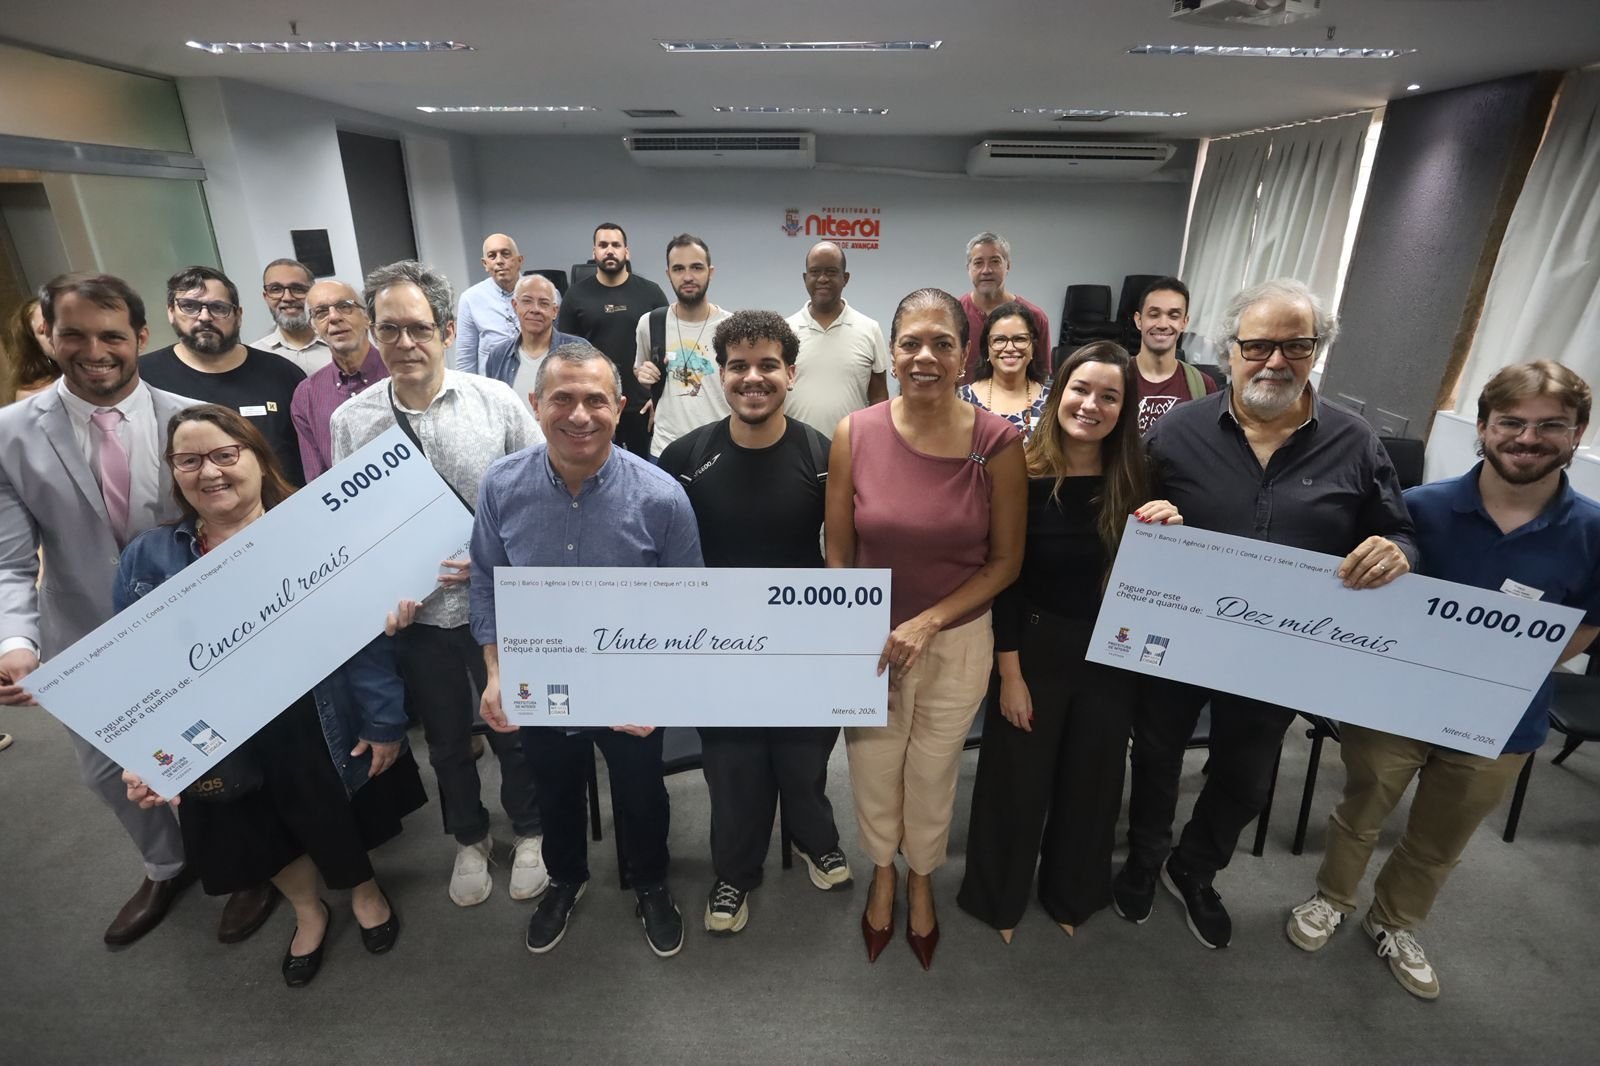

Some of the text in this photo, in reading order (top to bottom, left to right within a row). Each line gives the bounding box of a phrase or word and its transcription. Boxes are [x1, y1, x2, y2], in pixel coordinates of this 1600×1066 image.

[851, 242, 879, 250] AVANÇAR
[321, 443, 411, 512] 5.000,00
[447, 547, 464, 560] terói,
[1135, 529, 1153, 538] Comp
[1158, 534, 1177, 543] Banco
[1182, 539, 1206, 548] Agência
[1211, 544, 1221, 552] DV
[1240, 550, 1258, 559] Conta
[1299, 562, 1323, 573] Cheque
[767, 586, 883, 609] 20.000,00
[1116, 590, 1147, 602] cheque
[1155, 599, 1188, 611] quantia
[1189, 605, 1203, 615] de:
[1118, 582, 1181, 602] Pague por este
[38, 678, 59, 694] Comp
[63, 661, 85, 676] Banco
[89, 640, 114, 659] Agência
[117, 629, 128, 639] DV
[132, 620, 141, 628] C1
[145, 605, 165, 619] Conta
[168, 595, 177, 603] C2
[200, 564, 222, 580] Cheque
[233, 550, 242, 558] C3
[245, 541, 254, 549] R$
[189, 545, 349, 671] Cinco mil reais
[1427, 597, 1566, 643] 10.000,00
[1216, 596, 1397, 653] Dez mil reais
[503, 636, 563, 646] Pague por este
[503, 645, 533, 654] cheque
[541, 646, 573, 654] quantia
[593, 627, 769, 652] Vinte mil reais
[94, 688, 162, 738] Pague por este
[104, 718, 138, 743] cheque
[145, 687, 178, 714] quantia
[178, 677, 193, 689] de:
[831, 707, 857, 715] Niterói,
[1441, 727, 1471, 739] Niterói,
